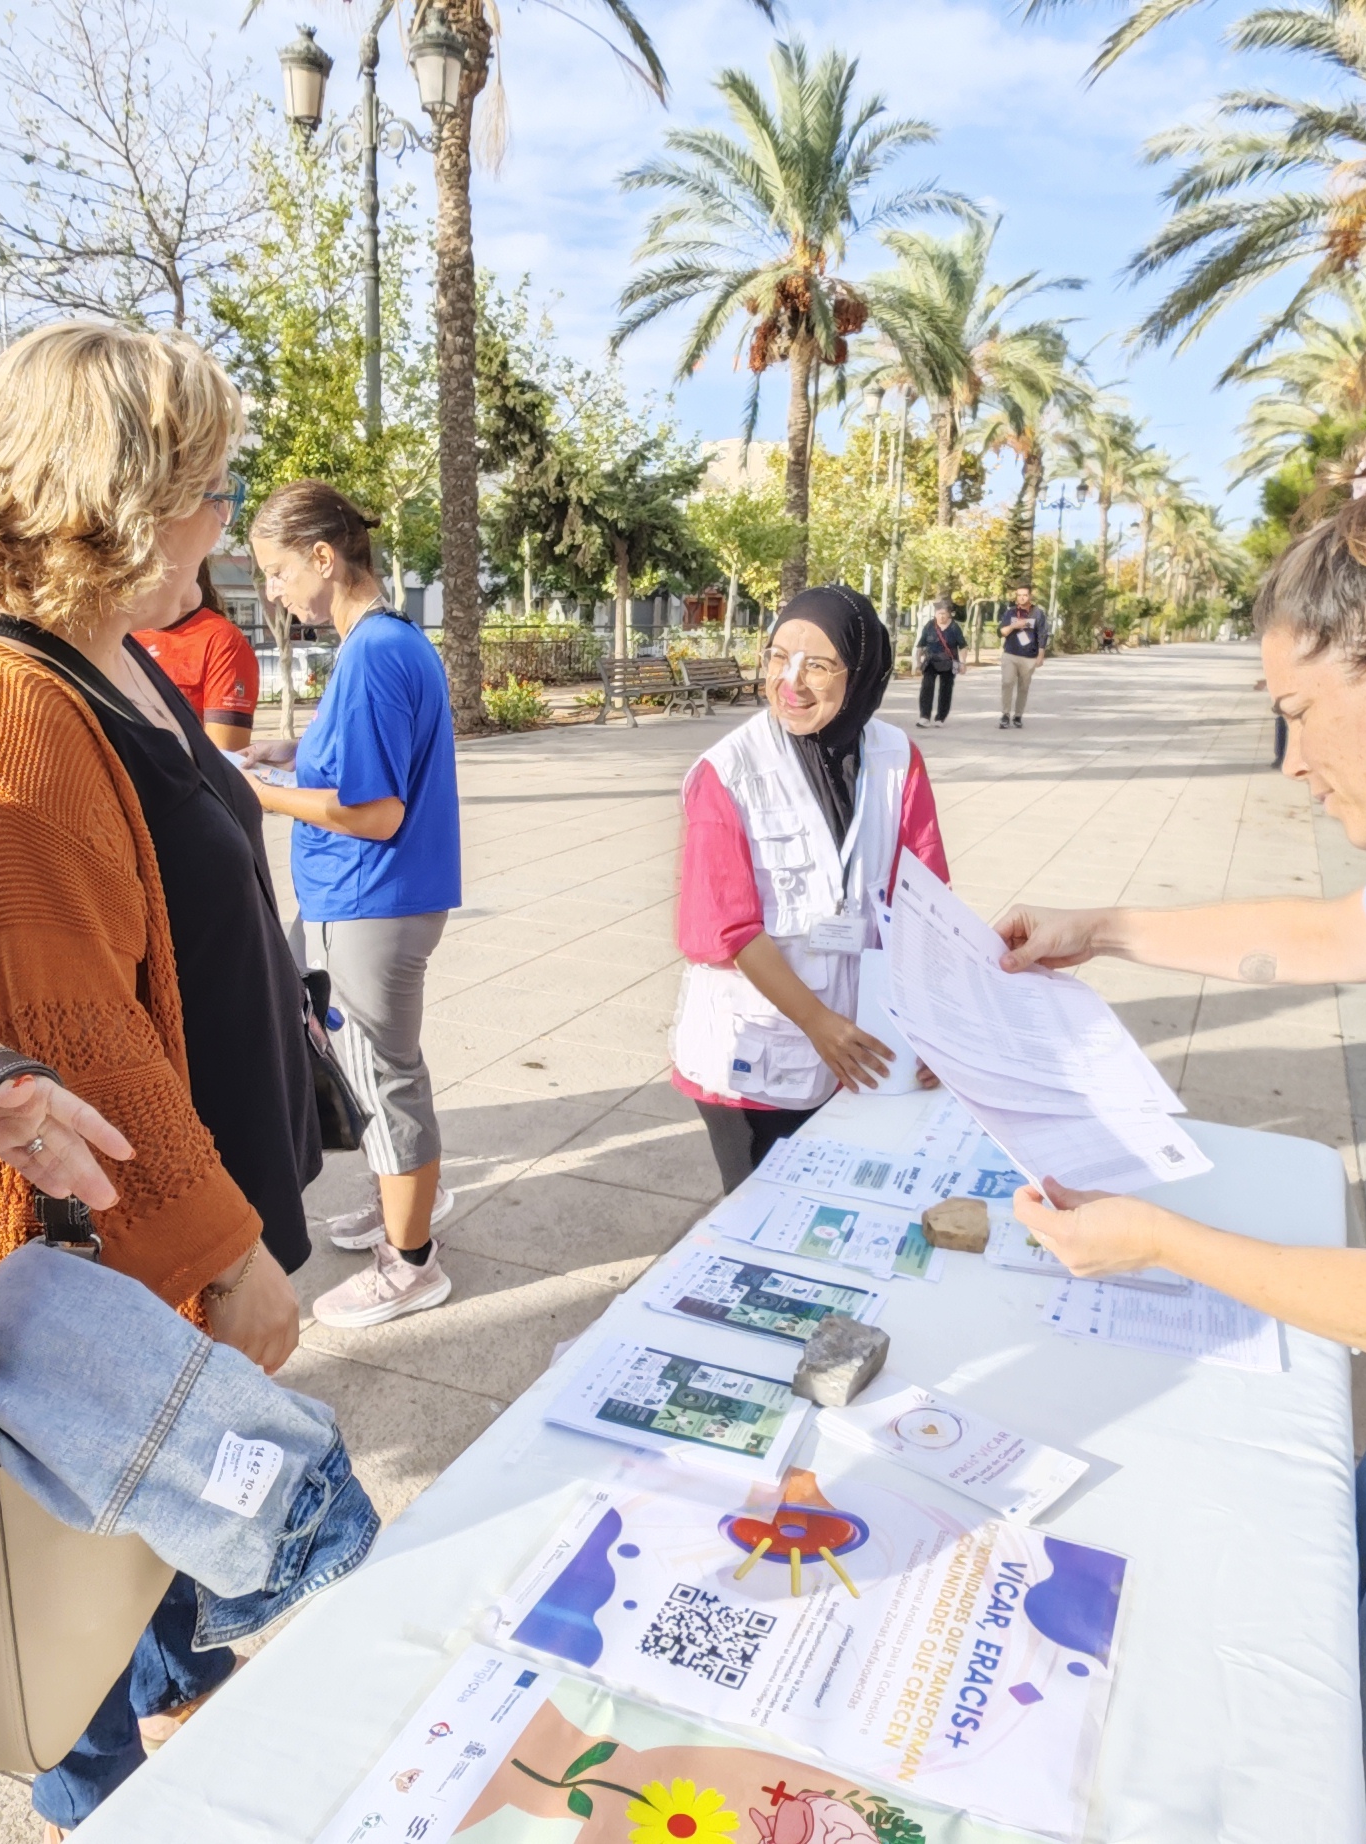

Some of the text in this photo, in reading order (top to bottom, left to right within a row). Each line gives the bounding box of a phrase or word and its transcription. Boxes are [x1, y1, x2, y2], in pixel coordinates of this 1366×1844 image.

[249, 1460, 261, 1475] 42
[254, 1445, 265, 1458] 14
[236, 1491, 249, 1507] 46
[243, 1477, 255, 1490] 10
[892, 1572, 914, 1599] Social
[911, 1566, 935, 1604] Regional
[876, 1610, 898, 1639] Zonas
[883, 1530, 974, 1748] COMUNIDADES QUE CRECEN
[894, 1603, 921, 1646] Andaluza
[883, 1644, 902, 1669] para
[897, 1519, 998, 1780] OPORTUNIDADES QUE TRANSFORMAN
[945, 1562, 1027, 1748] VÍCAR, ERACIS+
[846, 1637, 887, 1711] Desfavorecidas
[862, 1679, 891, 1728] Cohesión
